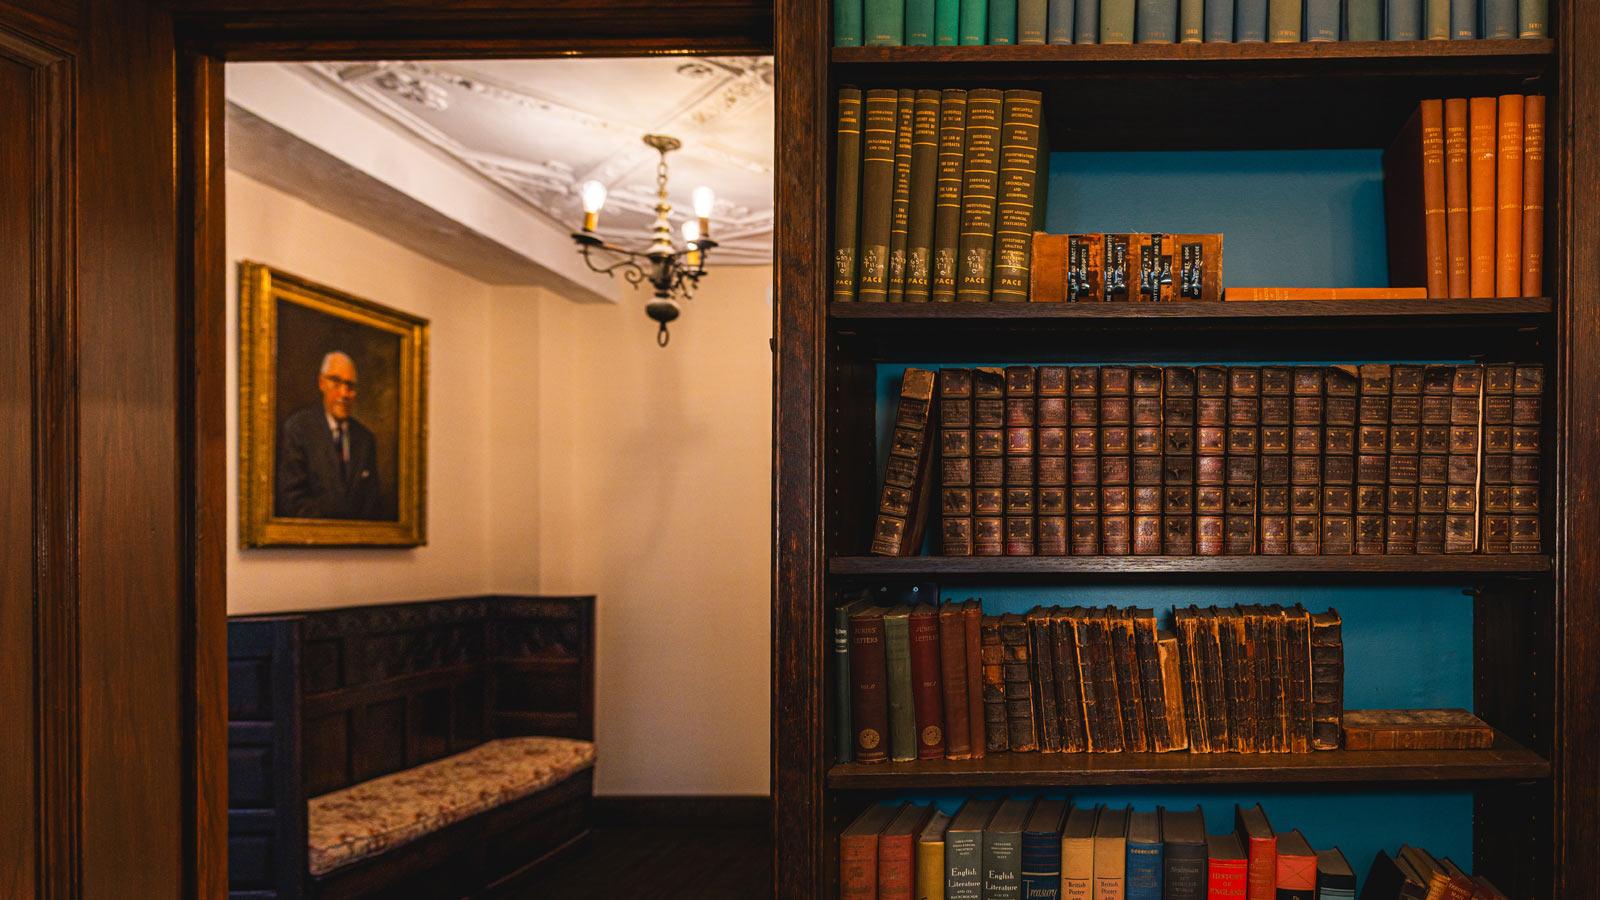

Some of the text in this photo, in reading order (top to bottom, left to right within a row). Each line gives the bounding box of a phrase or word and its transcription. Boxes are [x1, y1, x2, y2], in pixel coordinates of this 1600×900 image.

[951, 867, 977, 877] English
[988, 870, 1015, 880] English
[948, 879, 981, 888] Literature
[986, 881, 1018, 891] Literature
[1023, 880, 1058, 900] Treasury
